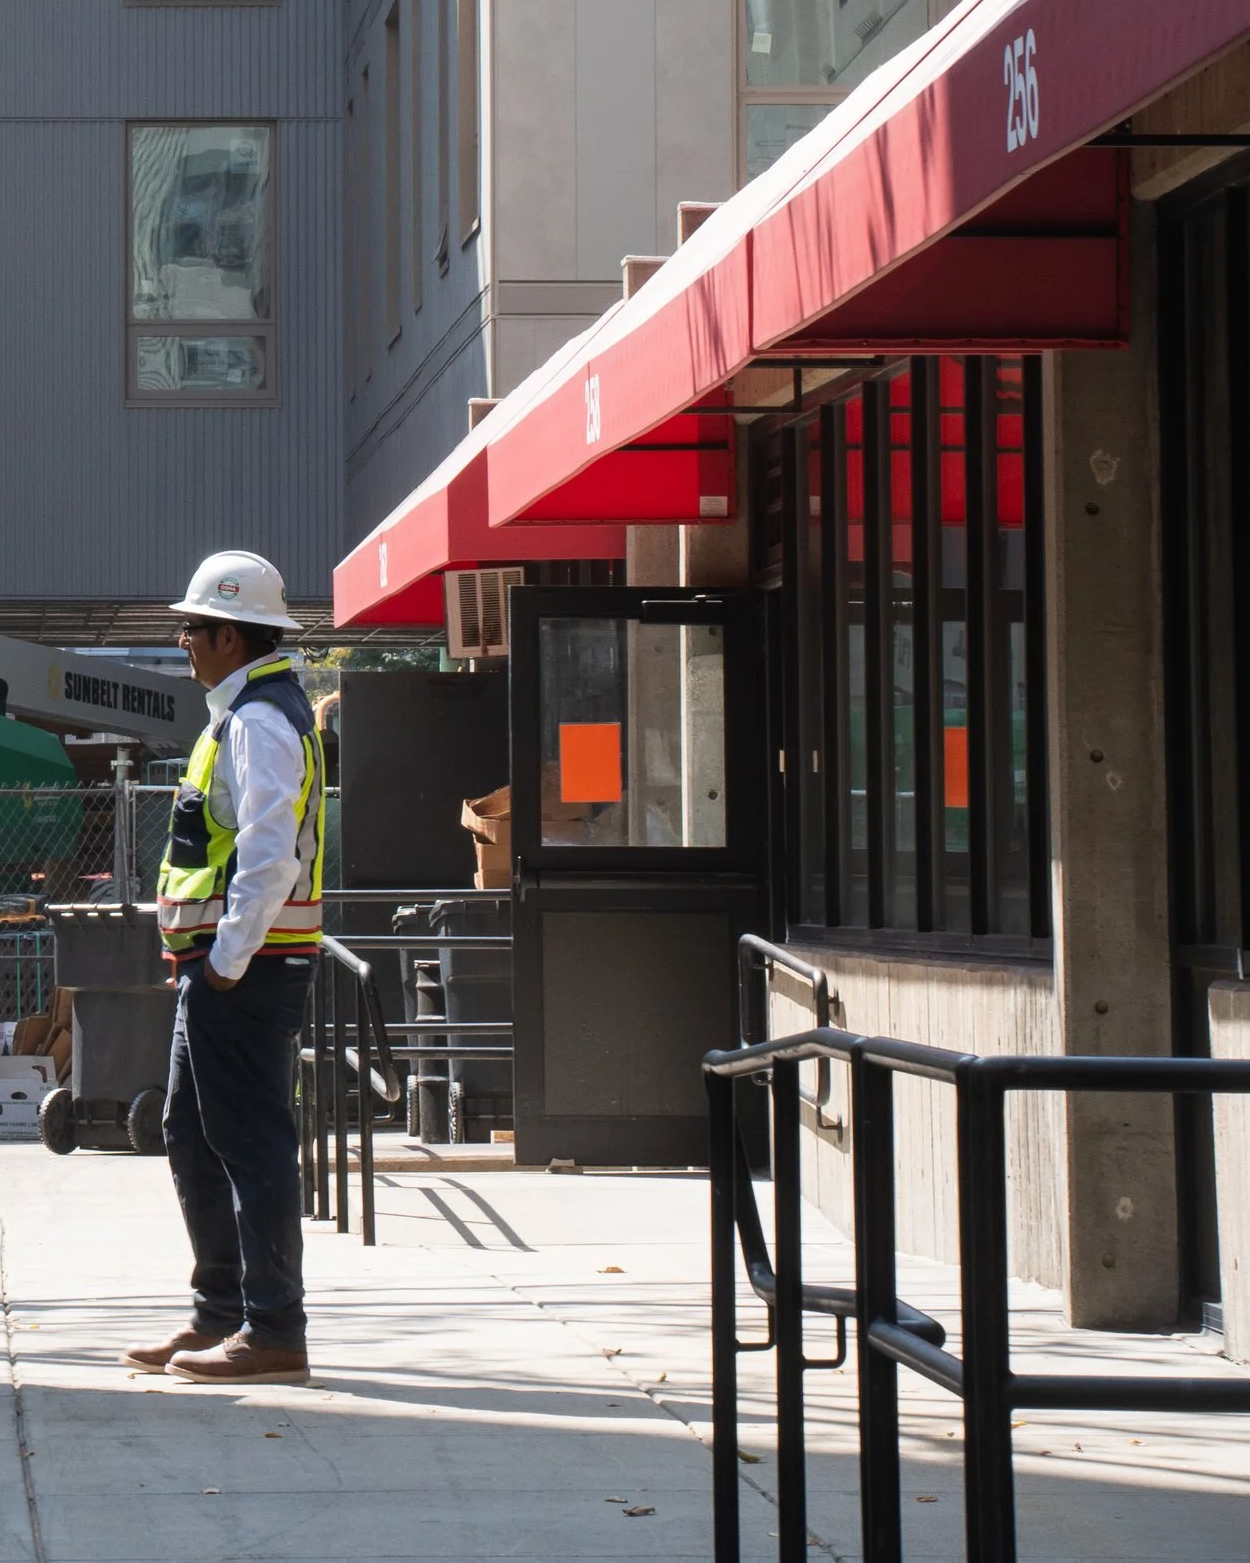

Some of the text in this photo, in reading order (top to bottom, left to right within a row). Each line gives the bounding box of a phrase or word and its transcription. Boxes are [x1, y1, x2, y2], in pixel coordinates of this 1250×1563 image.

[1003, 27, 1040, 154] 256
[584, 373, 601, 446] 258
[64, 671, 175, 722] SUNBELT RENTALS
